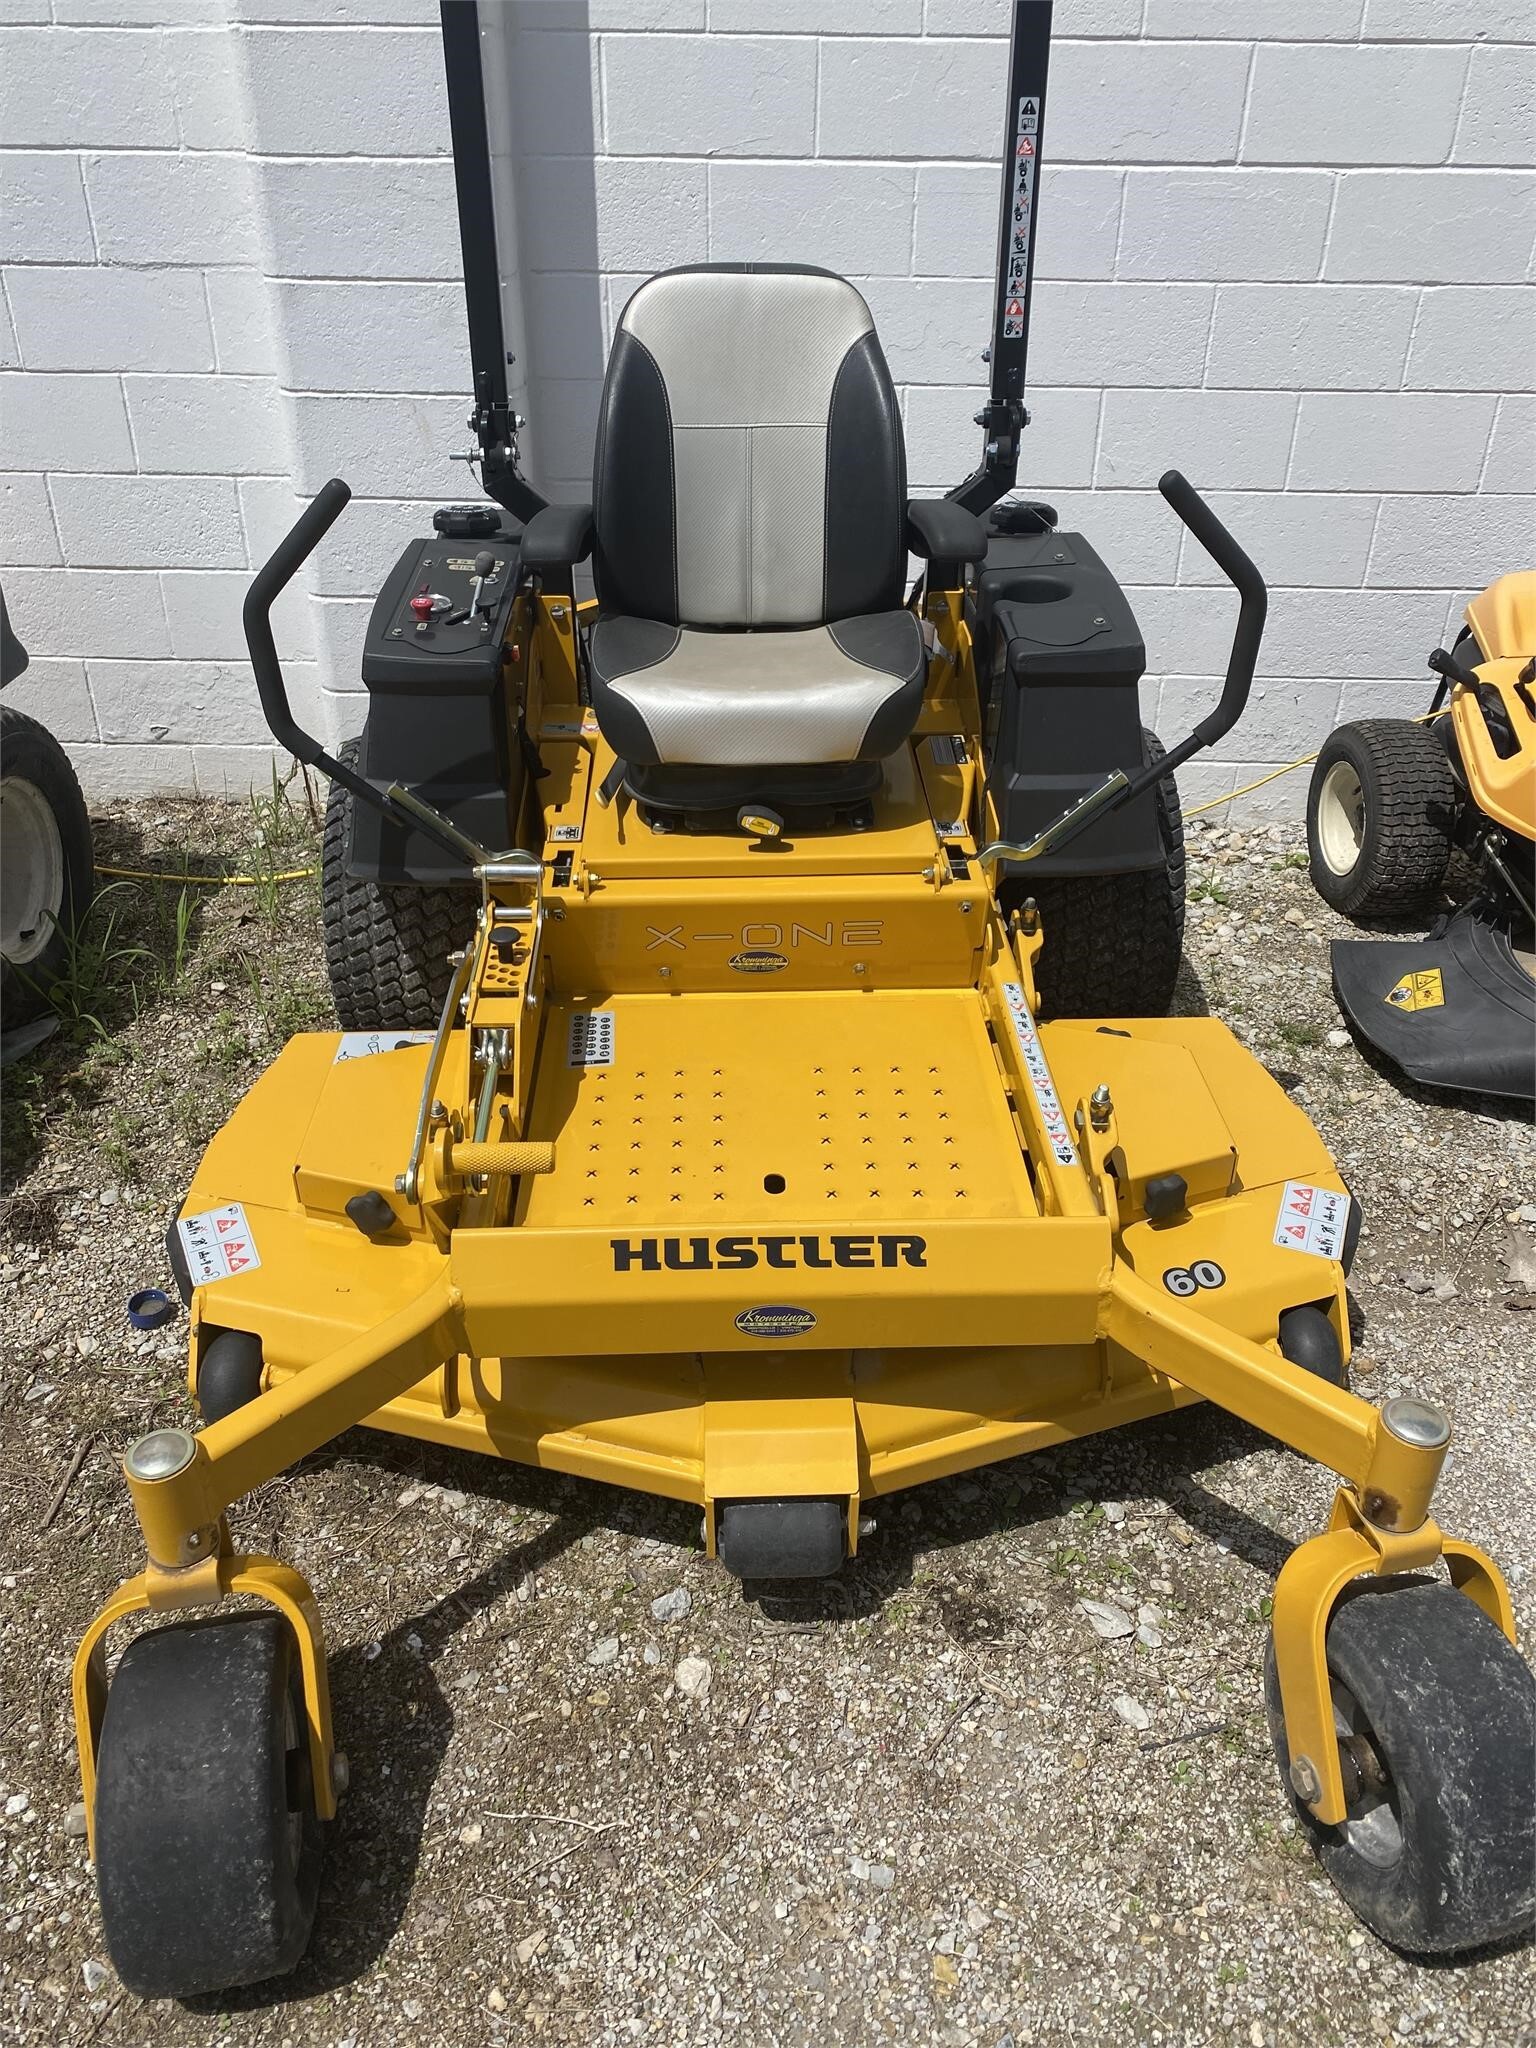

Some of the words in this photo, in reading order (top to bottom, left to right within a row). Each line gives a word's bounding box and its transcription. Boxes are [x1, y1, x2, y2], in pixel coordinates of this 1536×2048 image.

[646, 921, 883, 950] X-ONE
[610, 1235, 927, 1271] HUSTLER
[1163, 1260, 1226, 1297] 60
[744, 1310, 811, 1323] Kromminga
